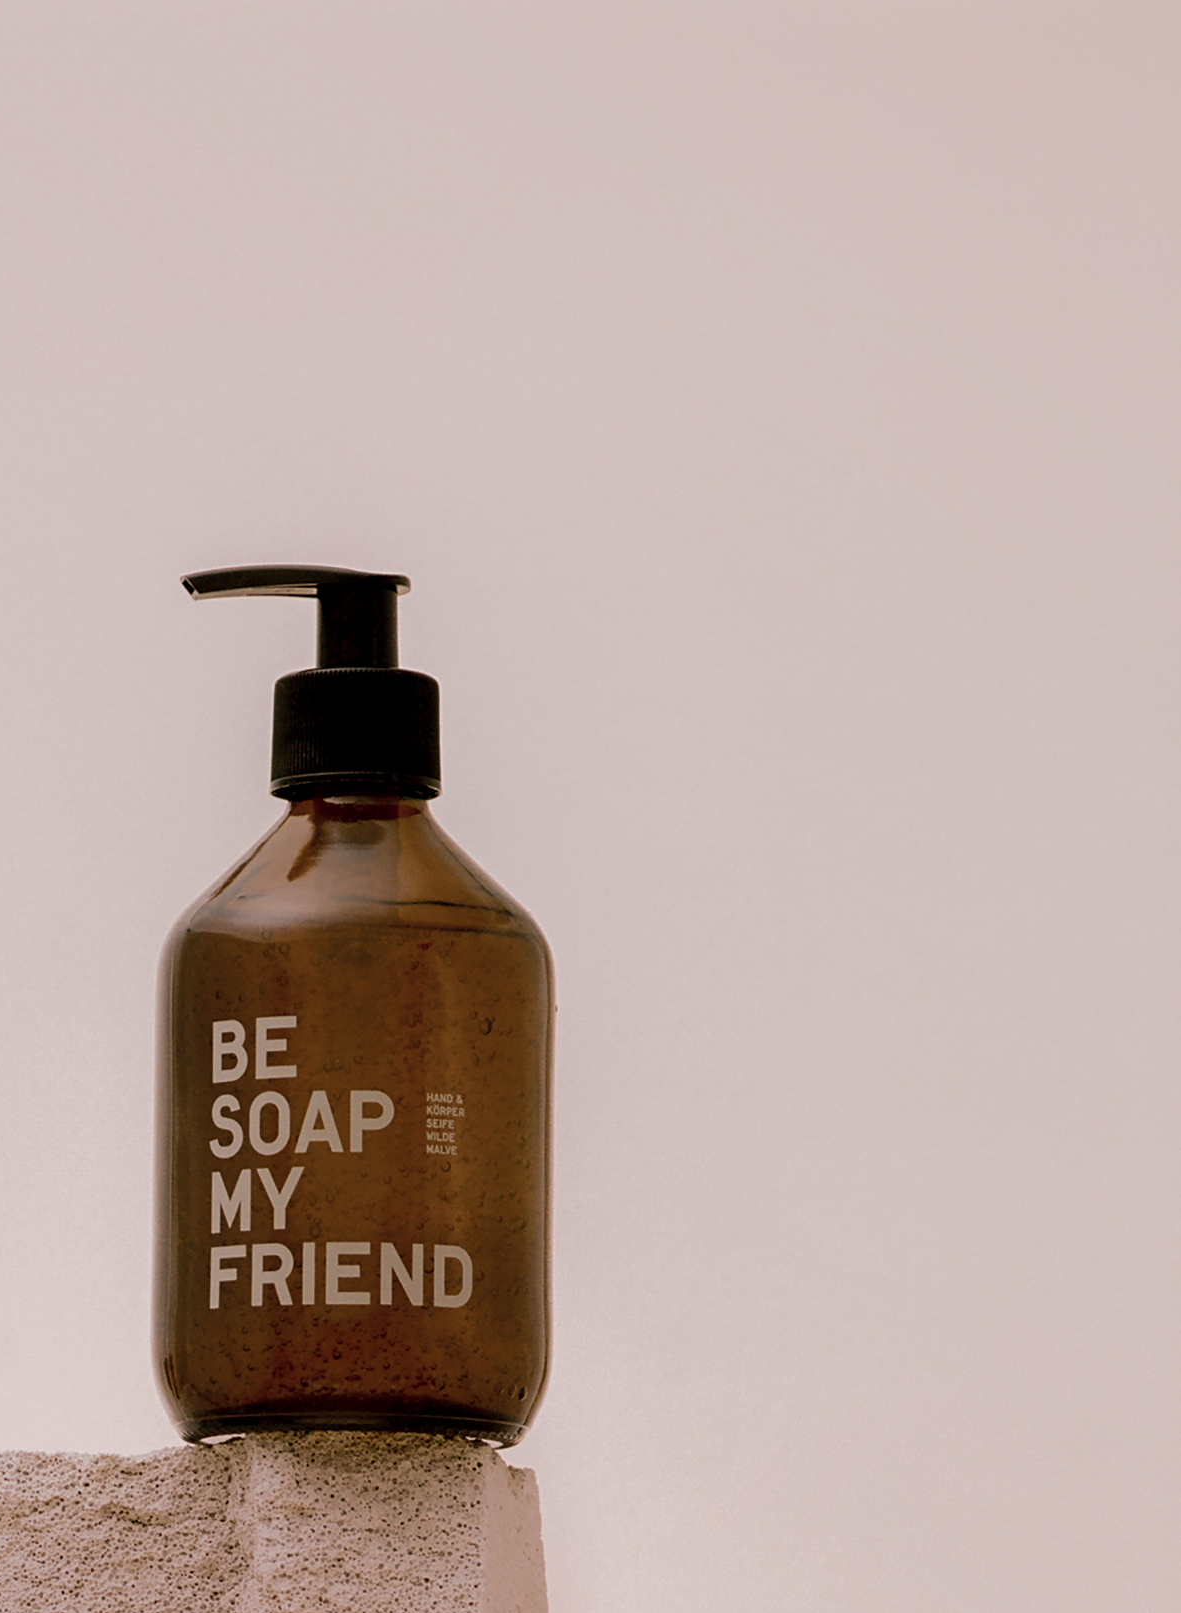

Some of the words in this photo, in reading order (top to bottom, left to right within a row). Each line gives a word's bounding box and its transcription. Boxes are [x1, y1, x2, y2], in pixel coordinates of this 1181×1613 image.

[212, 1015, 297, 1083] BE
[426, 1093, 453, 1103] HAND
[456, 1095, 464, 1104] &
[426, 1104, 465, 1117] KÖRPER
[209, 1090, 395, 1159] SOAP
[426, 1118, 455, 1129] SEIFE
[426, 1131, 455, 1142] WILDE
[426, 1145, 458, 1155] MALVE
[211, 1166, 305, 1234] MY
[209, 1242, 474, 1309] FRIEND
